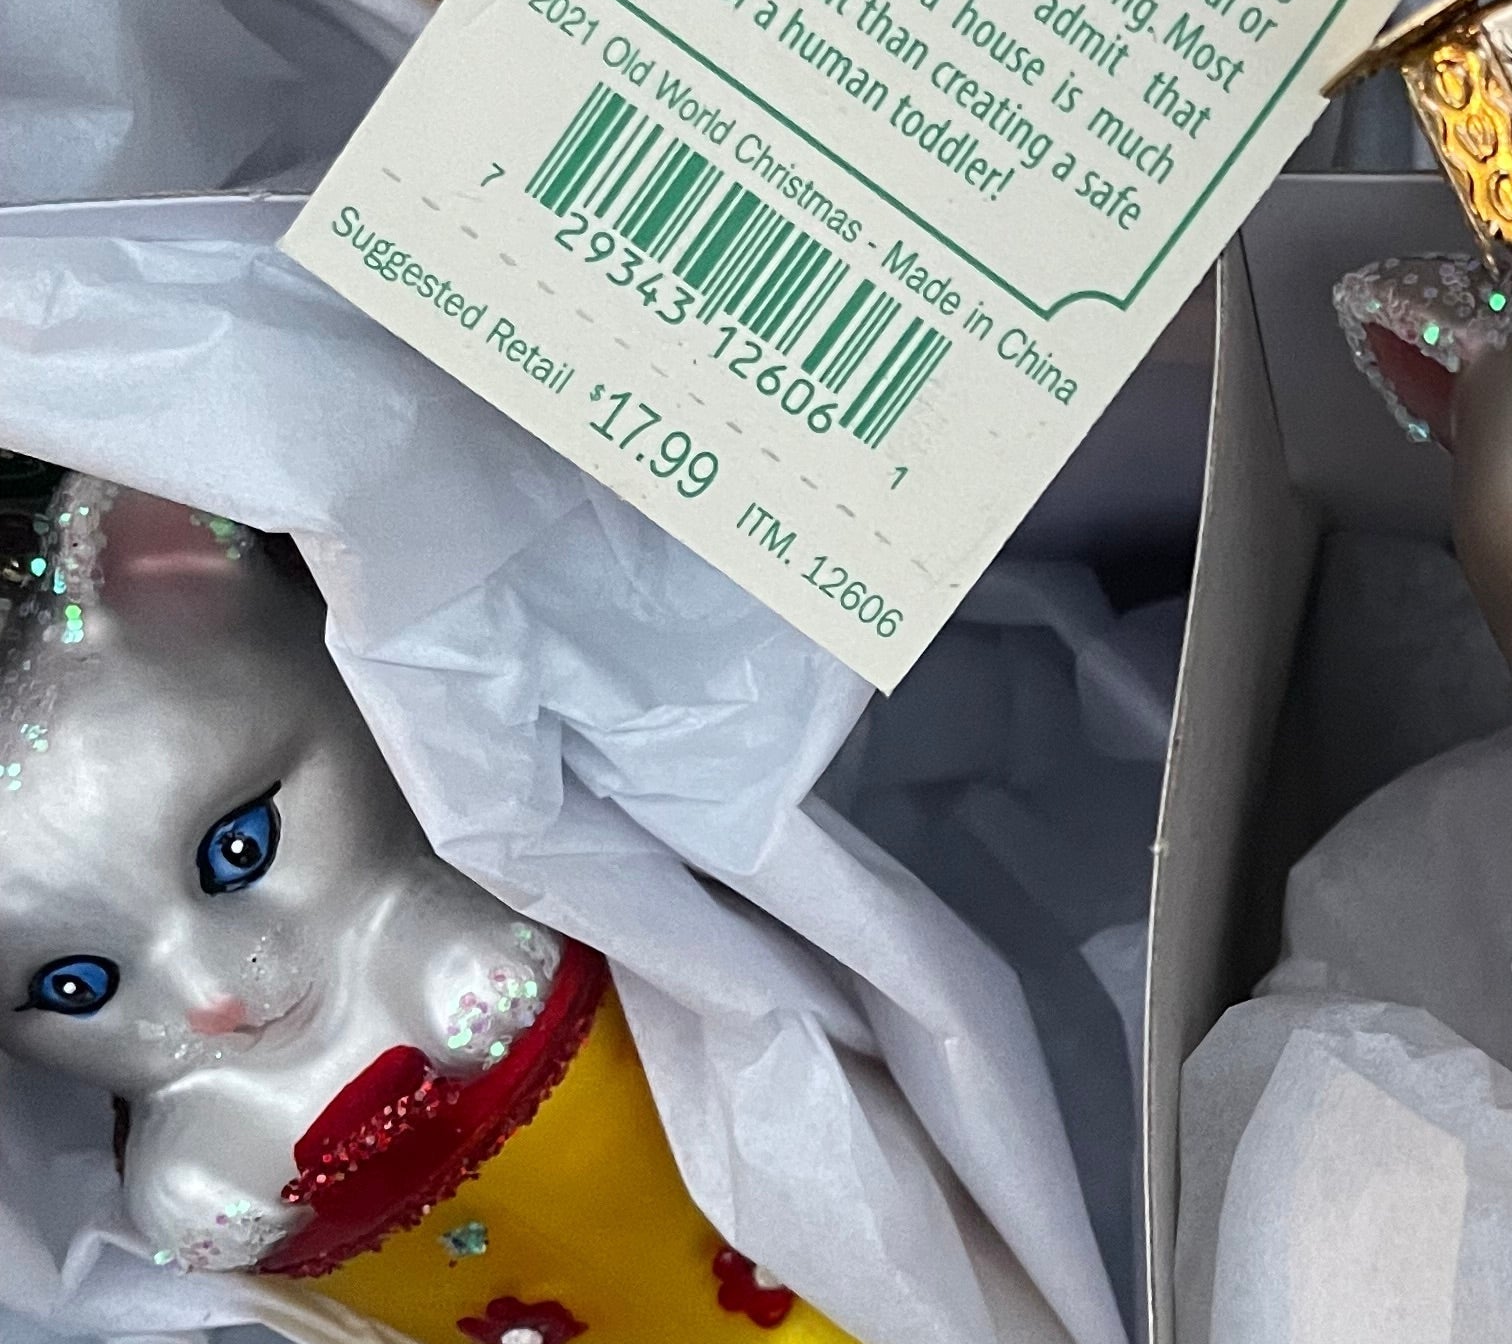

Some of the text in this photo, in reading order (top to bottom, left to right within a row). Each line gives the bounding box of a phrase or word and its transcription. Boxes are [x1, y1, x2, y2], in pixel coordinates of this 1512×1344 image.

[753, 0, 779, 31] a
[778, 7, 889, 113] human
[889, 94, 1016, 202] toddler!
[1142, 71, 1212, 140] that
[1162, 11, 1245, 94] Most
[1238, 6, 1279, 43] or
[930, 61, 1054, 170] creating
[1051, 151, 1077, 183] a
[1074, 170, 1142, 231] safe
[1050, 70, 1084, 114] is
[1086, 106, 1175, 185] much
[602, 35, 657, 88] Old
[655, 69, 737, 146] World
[734, 133, 863, 244] Christmas
[880, 239, 962, 316] Made
[962, 300, 994, 342] in
[996, 328, 1078, 406] China
[480, 162, 909, 491] 7 29343 12606 1
[331, 205, 904, 638] Suggested Retail $17.99 ITM. 12606
